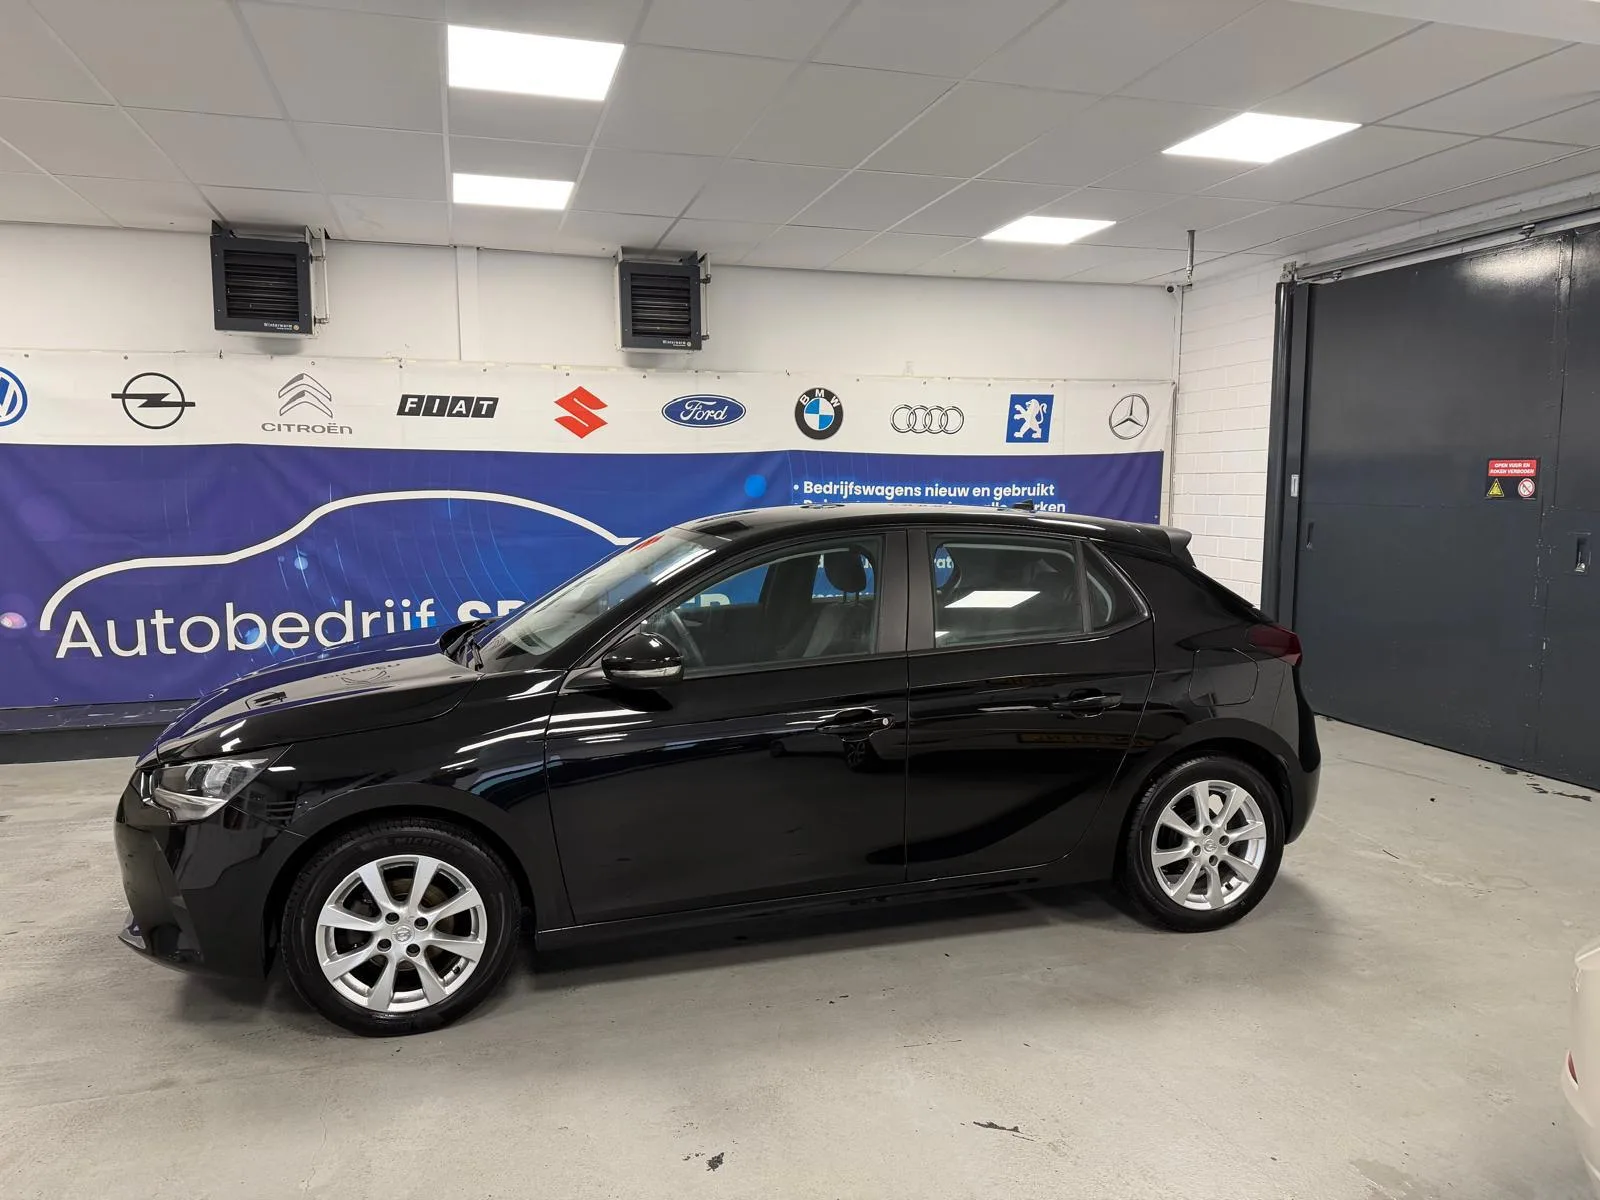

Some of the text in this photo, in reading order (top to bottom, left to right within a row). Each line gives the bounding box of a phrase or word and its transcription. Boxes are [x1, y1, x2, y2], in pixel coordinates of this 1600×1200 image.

[401, 396, 495, 417] FIAT
[799, 388, 841, 408] BMW
[678, 399, 730, 423] Ford
[803, 480, 1055, 501] Bedrijfswagens nieuw en gebruikt
